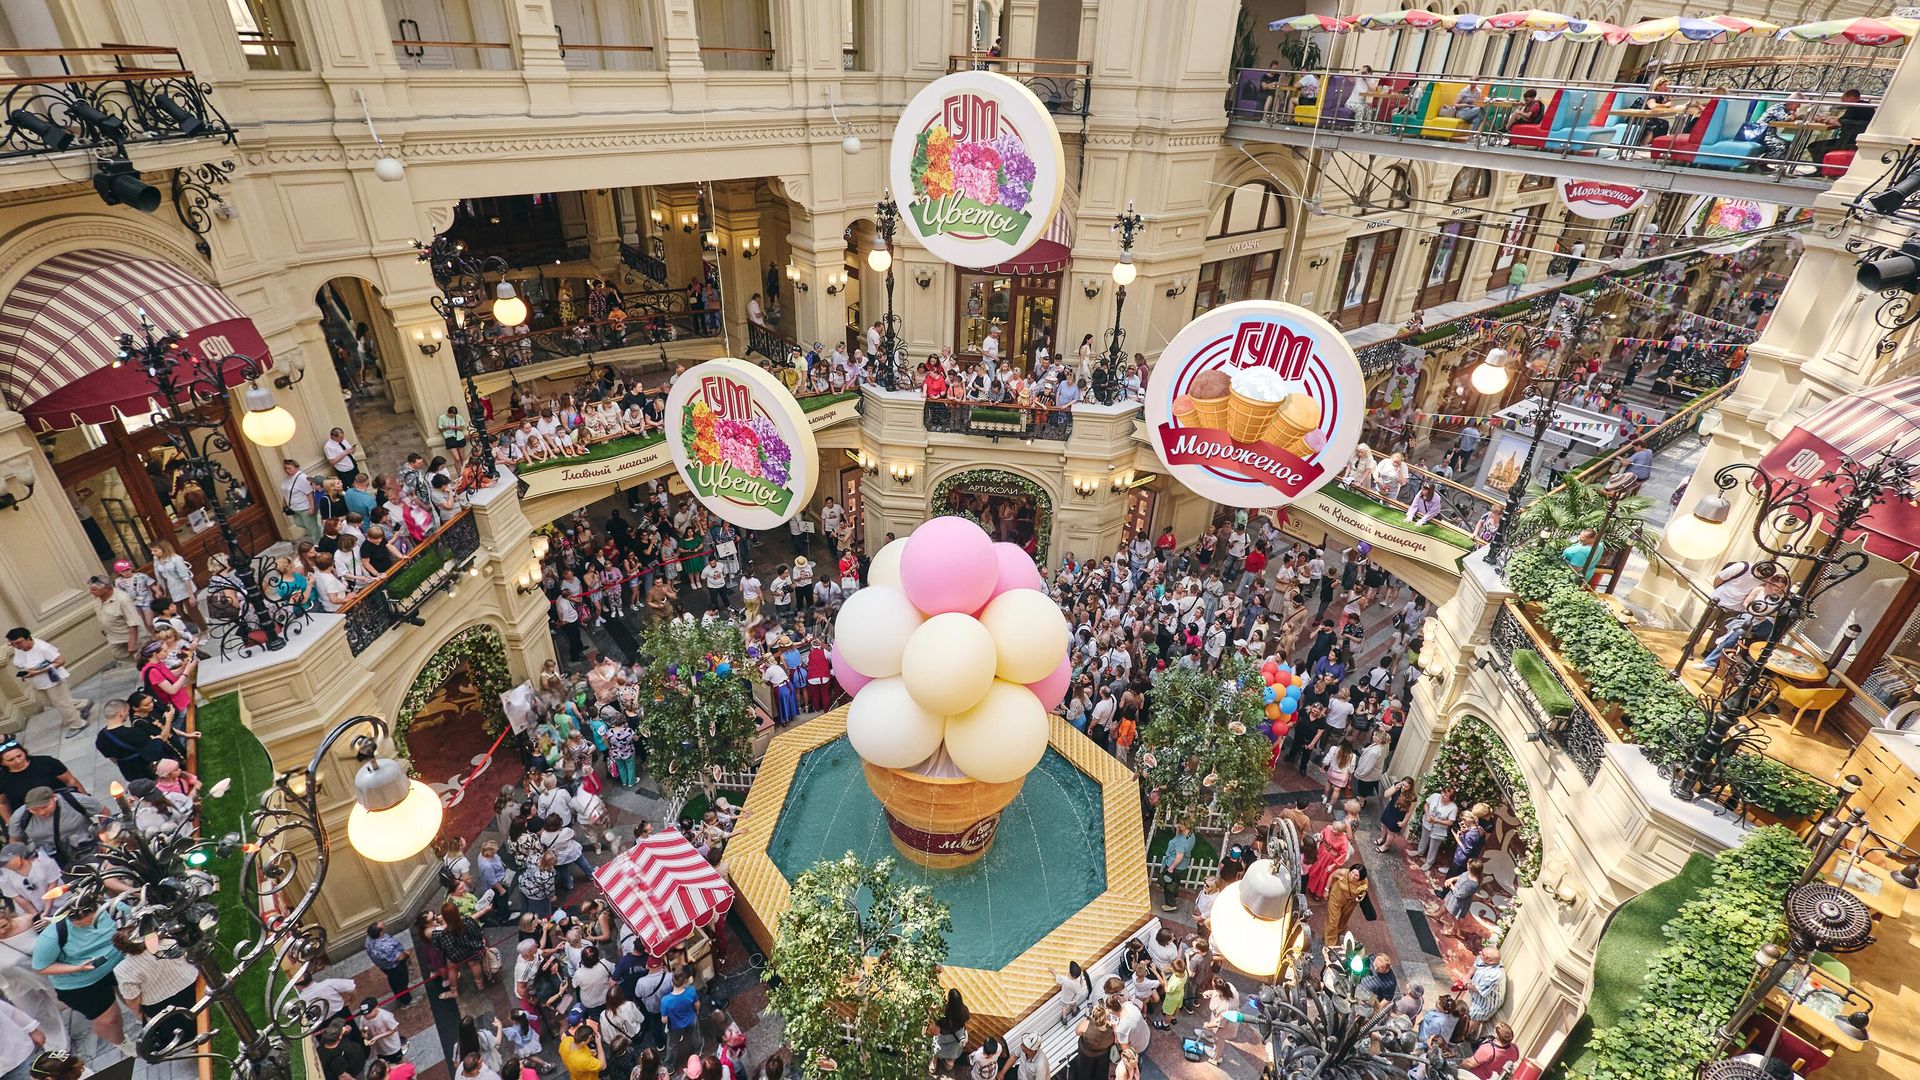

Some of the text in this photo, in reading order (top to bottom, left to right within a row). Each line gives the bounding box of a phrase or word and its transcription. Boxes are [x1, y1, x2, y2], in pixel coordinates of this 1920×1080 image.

[943, 94, 999, 143] ГУМ
[921, 188, 1018, 237] Цветы
[1569, 185, 1634, 204] Мороженое
[198, 335, 235, 361] ГУМ
[1229, 322, 1314, 380] ГУМ
[701, 376, 753, 421] ГУМ
[808, 410, 837, 425] лощади
[561, 454, 658, 481] Главный магазин
[695, 458, 782, 506] Цветы
[1170, 434, 1303, 486] Мороженое
[1785, 448, 1826, 480] ГУМ
[968, 484, 1018, 495] АРТИКОЛИ
[1318, 503, 1330, 514] на
[1332, 507, 1372, 533] Красной
[1374, 529, 1426, 552] площади
